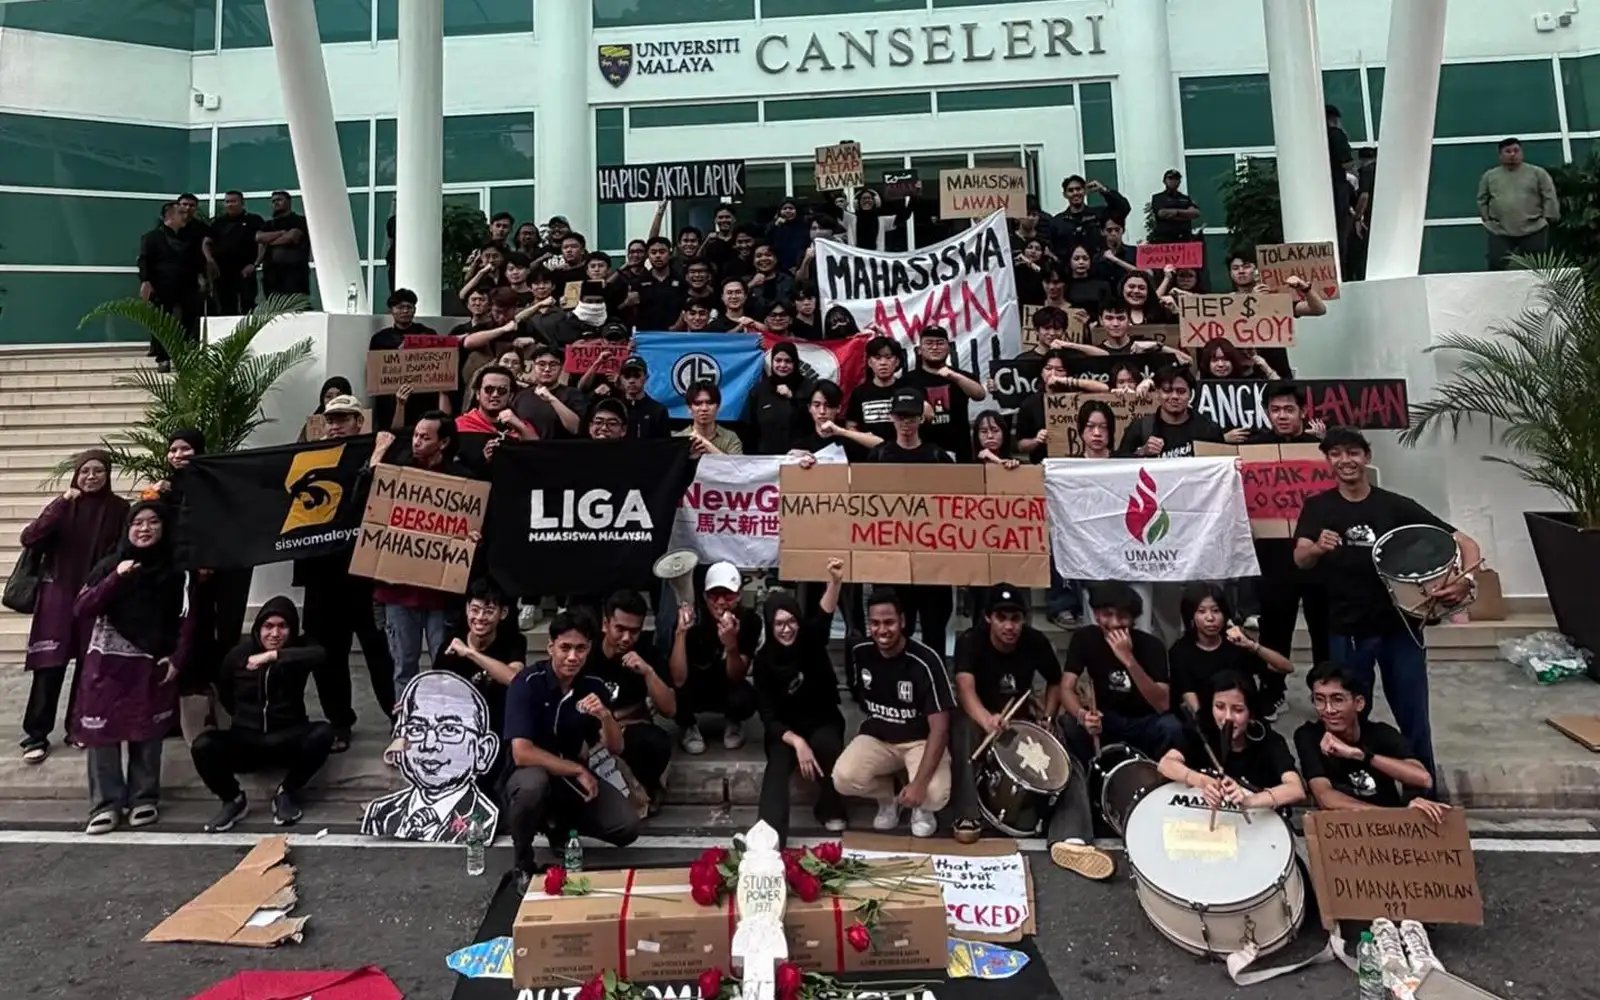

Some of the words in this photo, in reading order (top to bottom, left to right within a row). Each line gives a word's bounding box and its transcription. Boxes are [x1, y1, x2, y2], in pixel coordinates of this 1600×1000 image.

[635, 38, 740, 58] UNIVERSITI
[755, 15, 1106, 75] CANSELERI
[636, 57, 714, 75] MALAYA
[816, 145, 860, 164] LAWAN
[819, 160, 860, 174] TETAP
[598, 168, 650, 199] HAPUS
[654, 165, 692, 198] AKTA
[694, 163, 744, 197] LAPUK
[816, 171, 863, 189] LAWAN
[946, 173, 1024, 191] MAHASISWA
[953, 193, 1010, 211] LAWAN
[826, 227, 1006, 300] MAHASISWA
[1260, 244, 1307, 265] TOLAK
[874, 275, 1000, 345] AWAN
[1181, 297, 1234, 318] HEP
[1233, 316, 1293, 344] GOY!
[384, 353, 401, 364] UM
[1198, 382, 1273, 430] ANGK
[1304, 382, 1406, 428] LAWAN
[1243, 466, 1306, 487] ATAK
[376, 478, 482, 517] MAHASISWA
[676, 482, 779, 513] NewG
[781, 494, 929, 518] MAHASISWA
[933, 495, 1047, 522] TERGUGAT
[529, 488, 654, 530] LIGA
[390, 505, 469, 536] BERSAMA
[695, 512, 779, 536] 馬大新世
[275, 527, 361, 551] siswamalaya
[528, 531, 597, 542] MAHASISWA
[598, 531, 653, 542] MALAYSIA
[360, 529, 470, 569] MAHASISWA
[1124, 549, 1178, 561] UMANY
[1168, 794, 1240, 810] MAXON
[1324, 822, 1362, 839] SATU
[936, 858, 973, 871] that
[953, 881, 996, 890] week
[1334, 877, 1353, 899] DI
[1355, 878, 1402, 899] MANA
[1403, 879, 1473, 899] KEADILAN
[746, 889, 782, 904] POWER
[945, 903, 1027, 927] CKED!
[1384, 902, 1408, 917] ???
